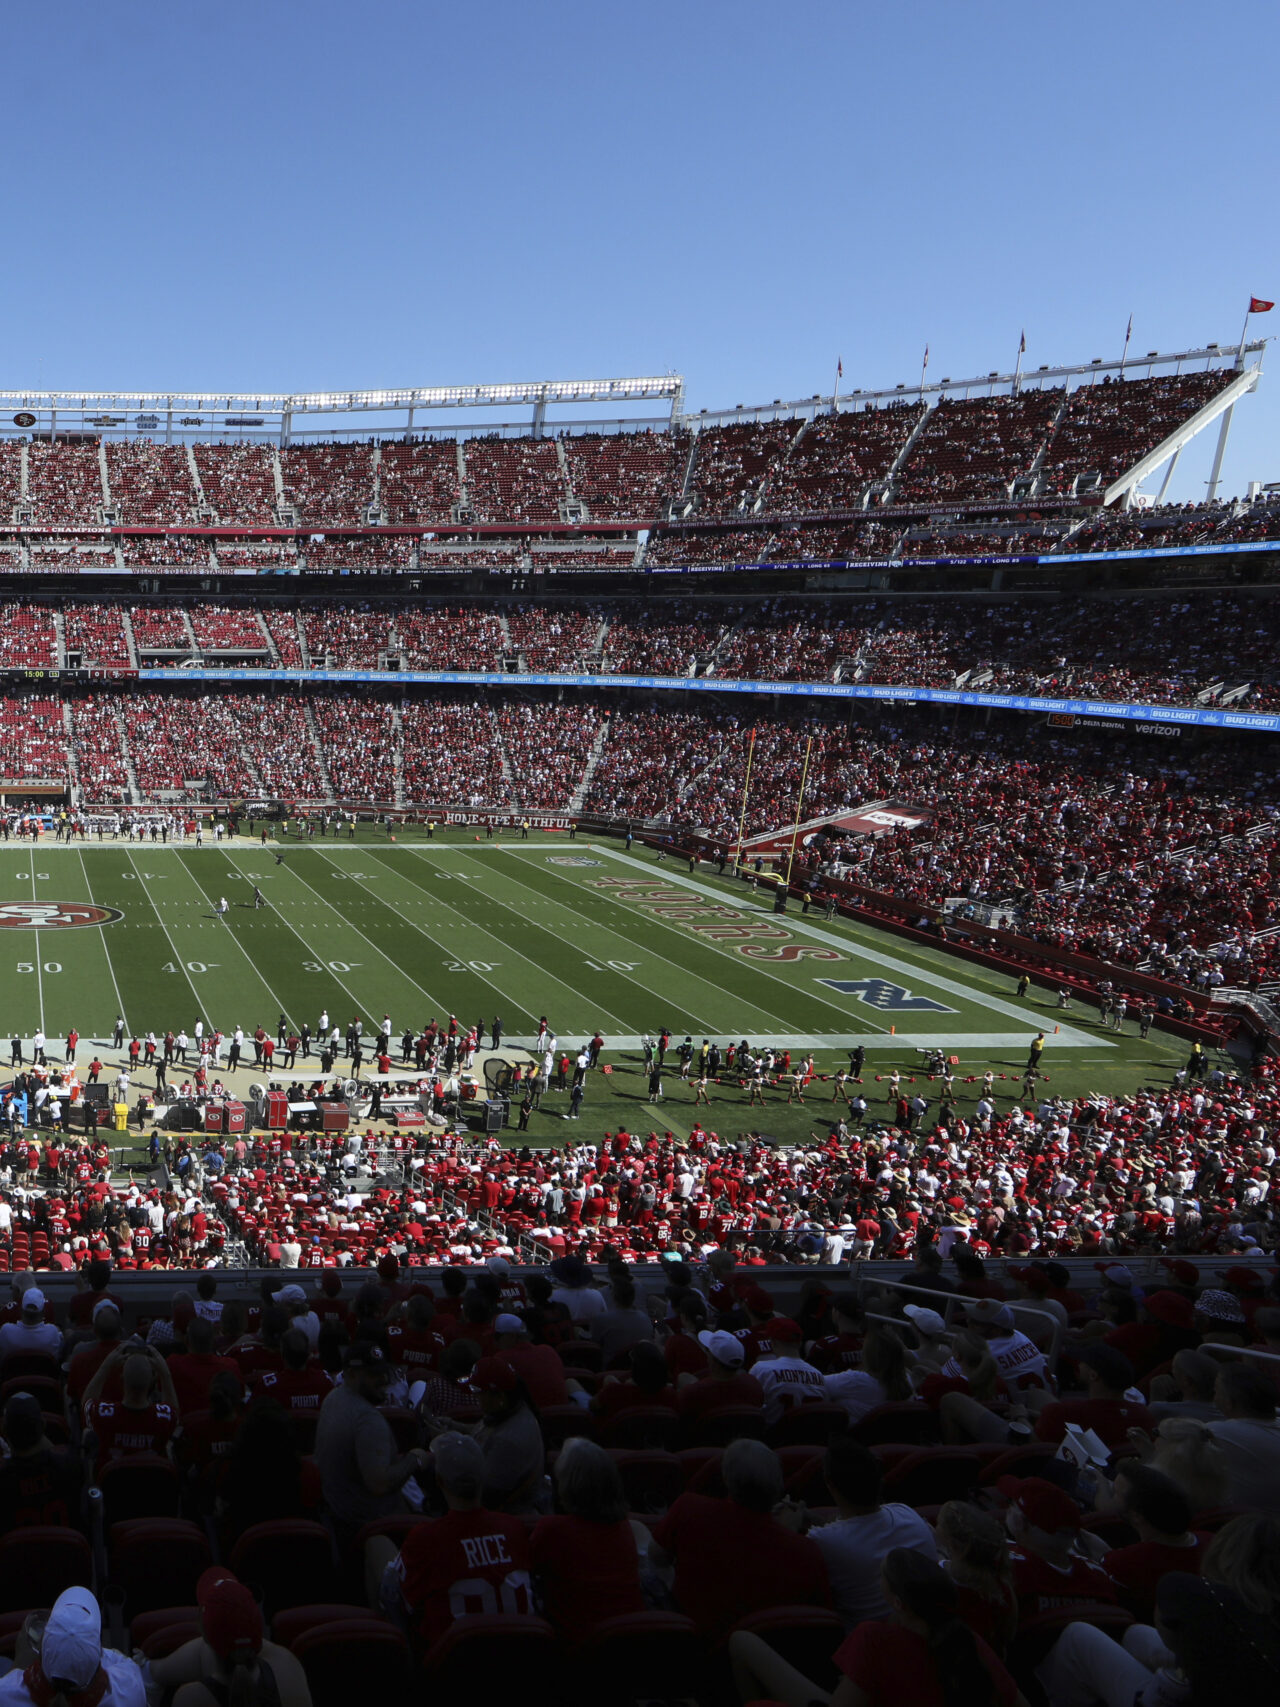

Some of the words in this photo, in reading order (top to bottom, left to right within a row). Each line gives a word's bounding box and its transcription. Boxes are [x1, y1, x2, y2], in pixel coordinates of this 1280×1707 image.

[969, 503, 1018, 511] DESCRIPTION,
[1052, 714, 1073, 725] 15:00
[1170, 712, 1196, 720] LIGHT
[1226, 716, 1244, 724] BUD
[1246, 718, 1275, 727] LIGHT
[1136, 724, 1181, 736] verizon
[447, 813, 478, 824] HOME
[16, 962, 63, 973] 50
[161, 962, 206, 973] 40
[302, 962, 351, 972] 30
[442, 961, 493, 971] 20
[582, 960, 634, 971] 10
[136, 1236, 149, 1247] 80
[312, 1255, 320, 1264] 19
[402, 1349, 432, 1363] PURDY
[773, 1370, 824, 1386] MONTANA
[291, 1394, 320, 1408] PURDY
[115, 1433, 154, 1448] PURDY
[460, 1535, 512, 1569] RICE
